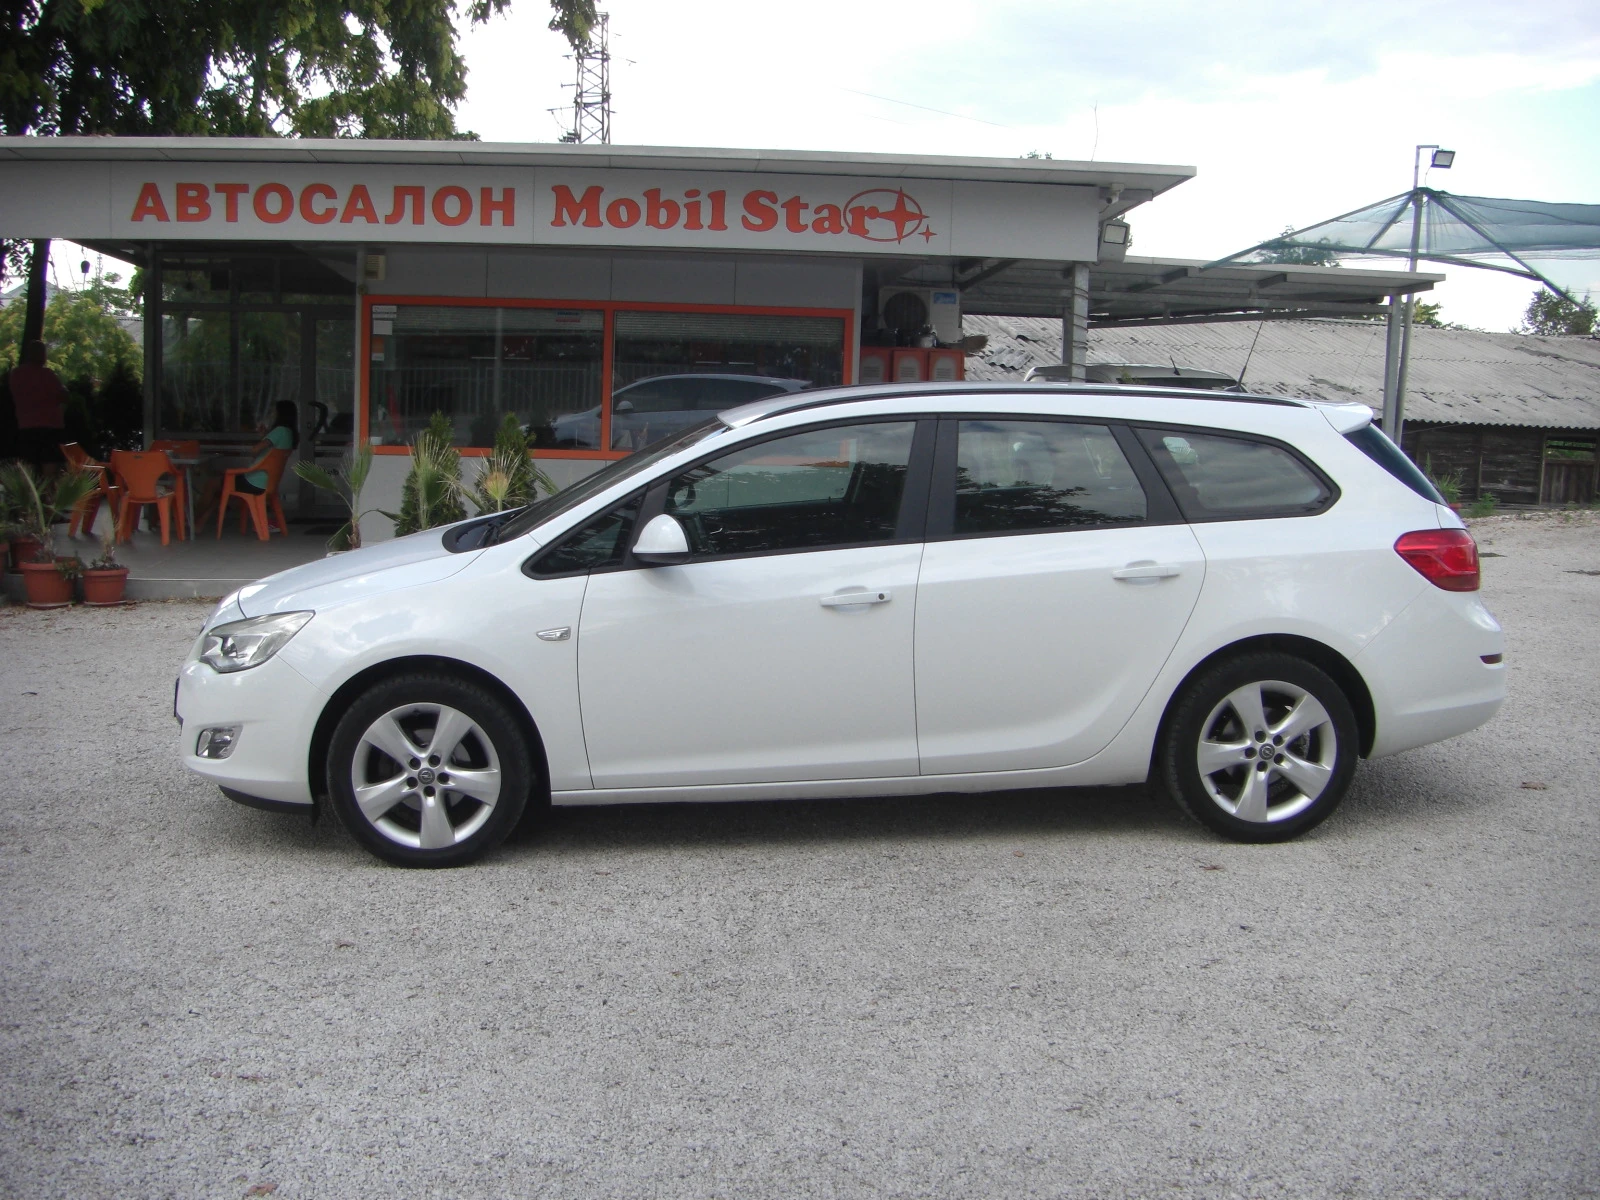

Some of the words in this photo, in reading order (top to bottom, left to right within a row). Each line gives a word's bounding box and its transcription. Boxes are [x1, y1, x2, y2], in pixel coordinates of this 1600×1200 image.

[131, 182, 516, 226] АВТОСАЛОН
[550, 184, 729, 231] Mobil
[741, 189, 880, 236] Star
